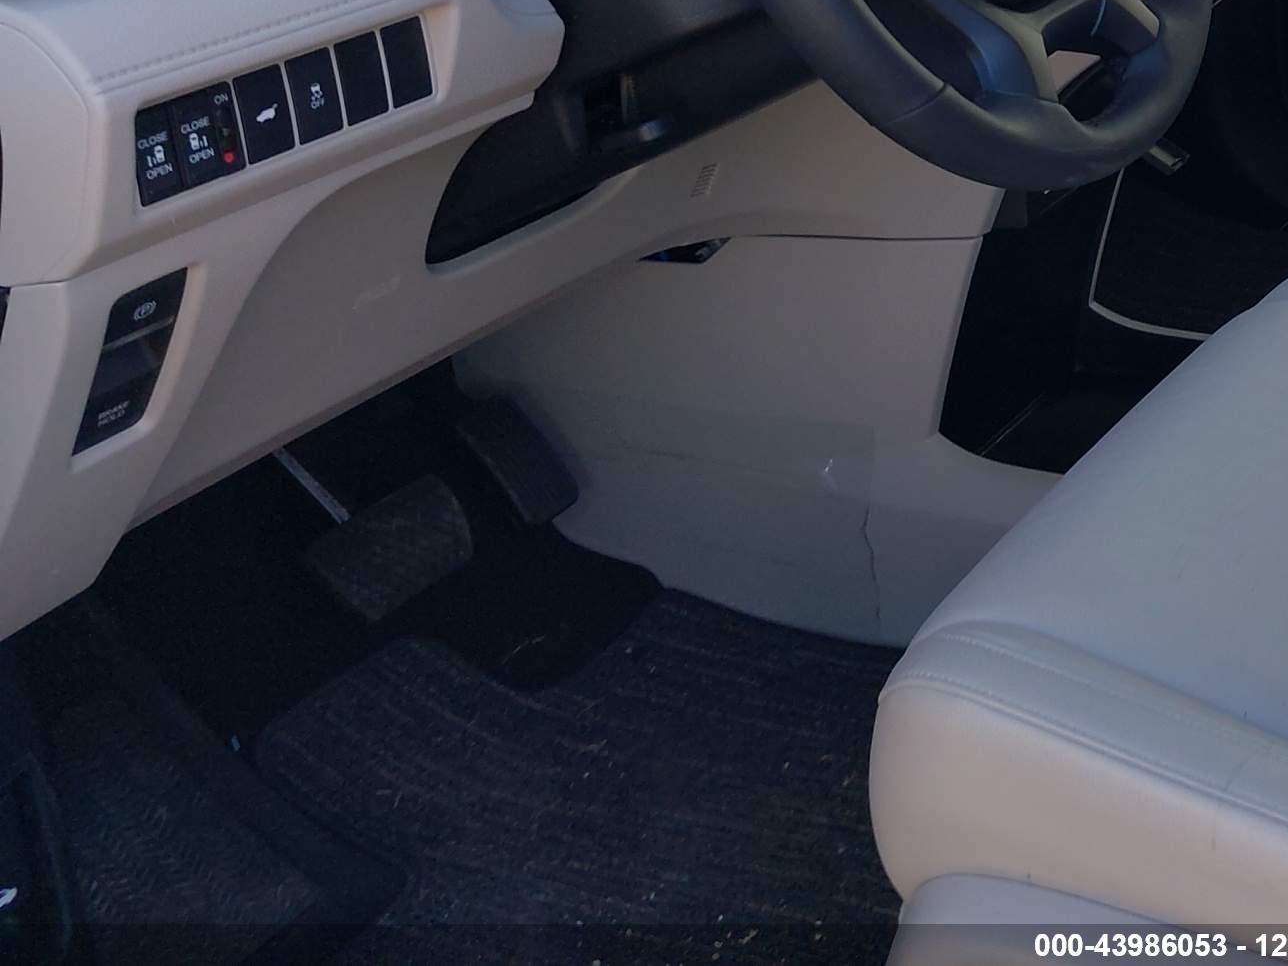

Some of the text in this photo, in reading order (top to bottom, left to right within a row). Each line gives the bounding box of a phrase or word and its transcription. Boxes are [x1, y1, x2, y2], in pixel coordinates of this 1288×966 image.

[214, 93, 228, 105] ON
[181, 116, 209, 134] CLOSE
[137, 131, 168, 149] CLOSE
[189, 148, 214, 163] OPEN
[146, 163, 173, 179] OPEN
